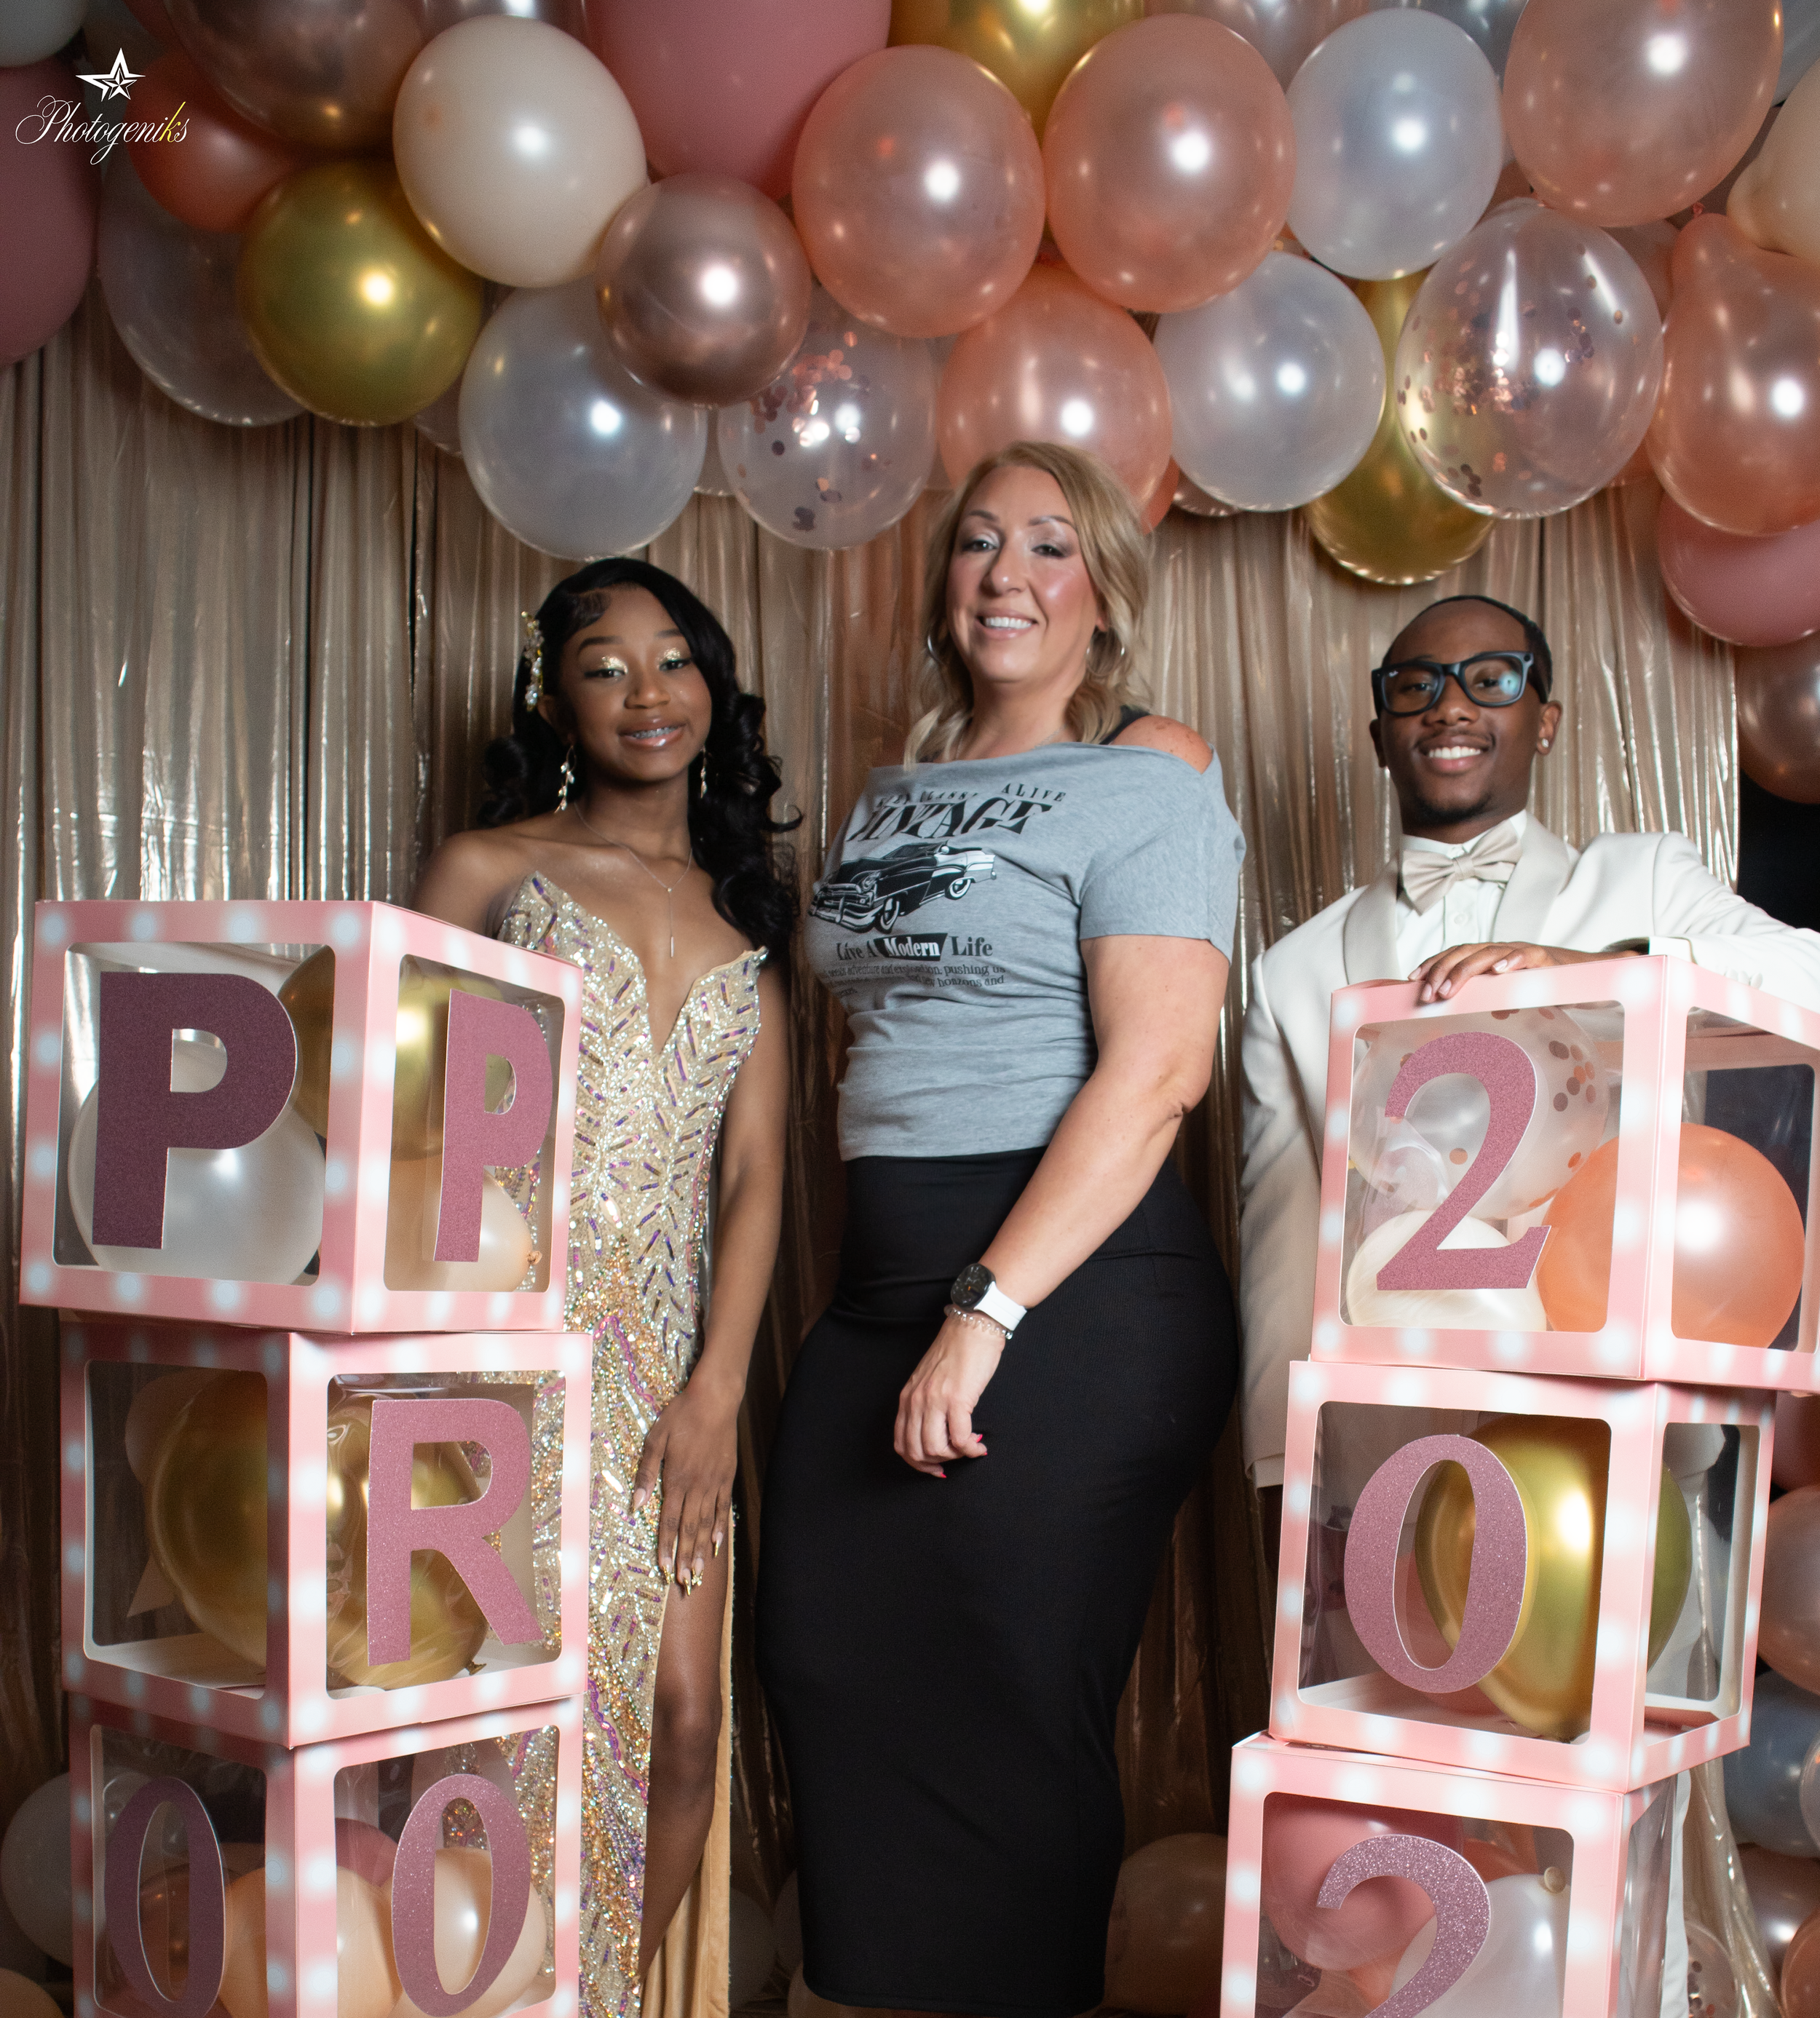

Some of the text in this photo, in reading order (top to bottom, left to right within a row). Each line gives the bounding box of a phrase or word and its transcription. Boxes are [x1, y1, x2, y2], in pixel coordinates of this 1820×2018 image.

[835, 941, 865, 961] Live
[883, 935, 941, 957] Modern
[949, 936, 994, 957] Life
[943, 964, 990, 977] pushing
[992, 965, 1006, 973] us
[984, 975, 1005, 986] and
[92, 971, 297, 1249] P
[433, 988, 553, 1263] P
[1376, 1032, 1551, 1291] 2
[367, 1397, 545, 1667] R
[1316, 1833, 1492, 2018] 2
